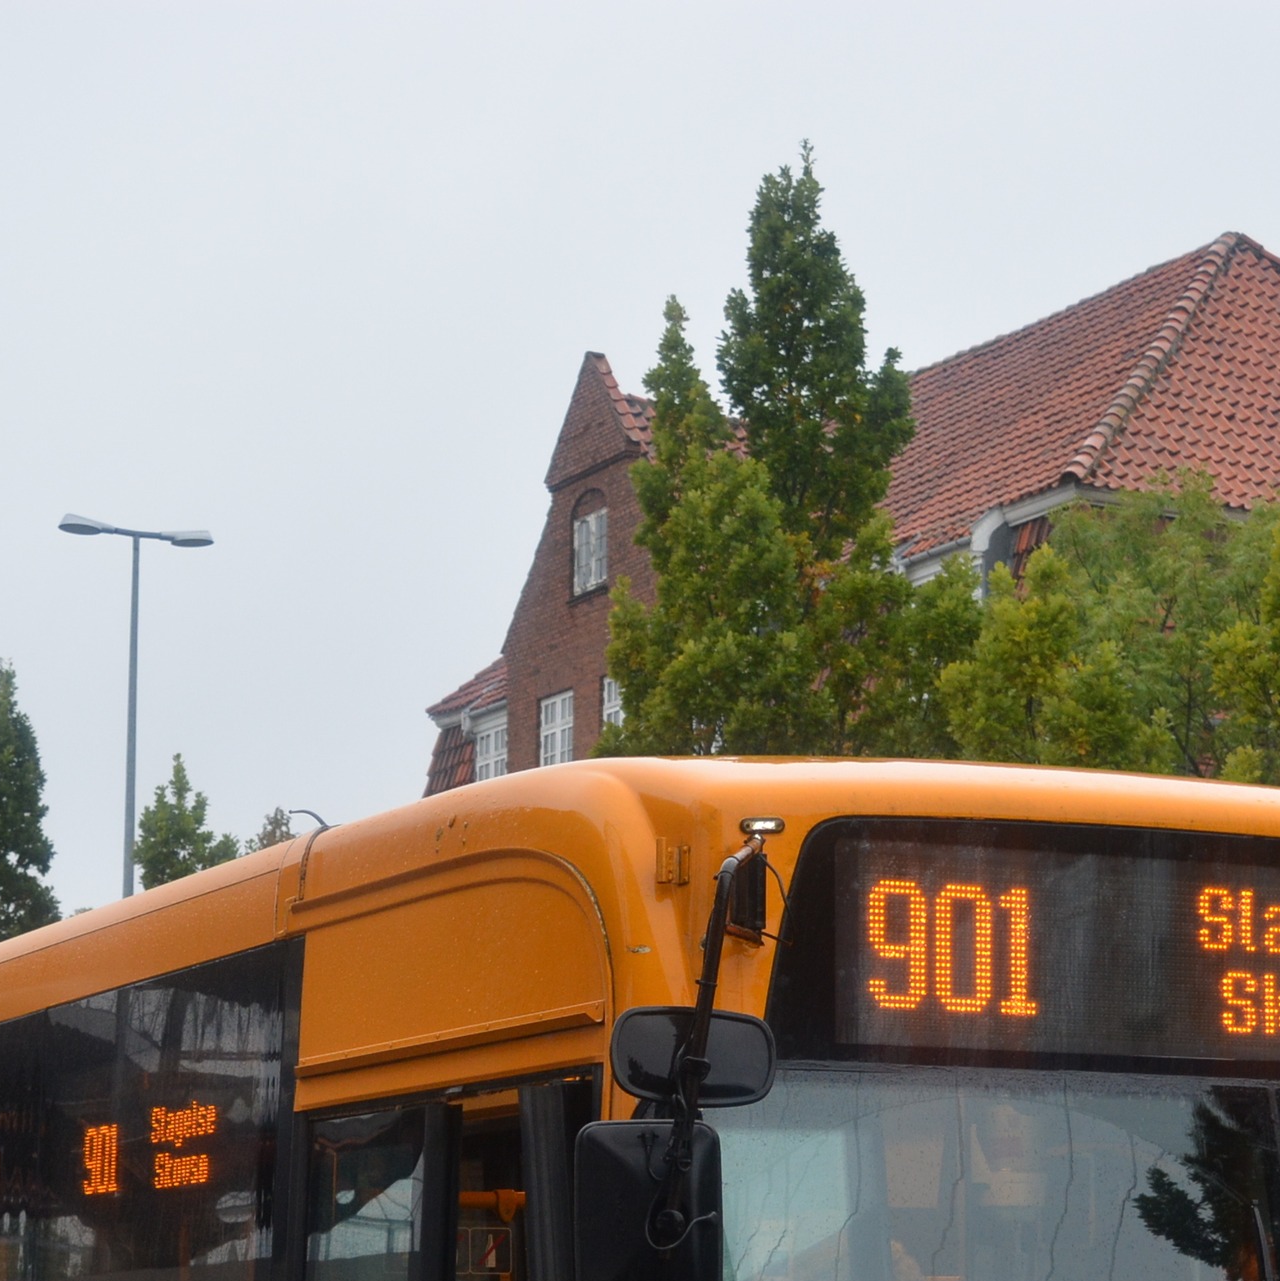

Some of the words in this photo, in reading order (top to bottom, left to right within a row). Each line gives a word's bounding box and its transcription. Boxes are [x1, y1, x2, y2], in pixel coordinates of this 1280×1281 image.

[868, 878, 1038, 1016] 901
[82, 1123, 118, 1196] 901
[150, 1100, 217, 1148] Slagelse
